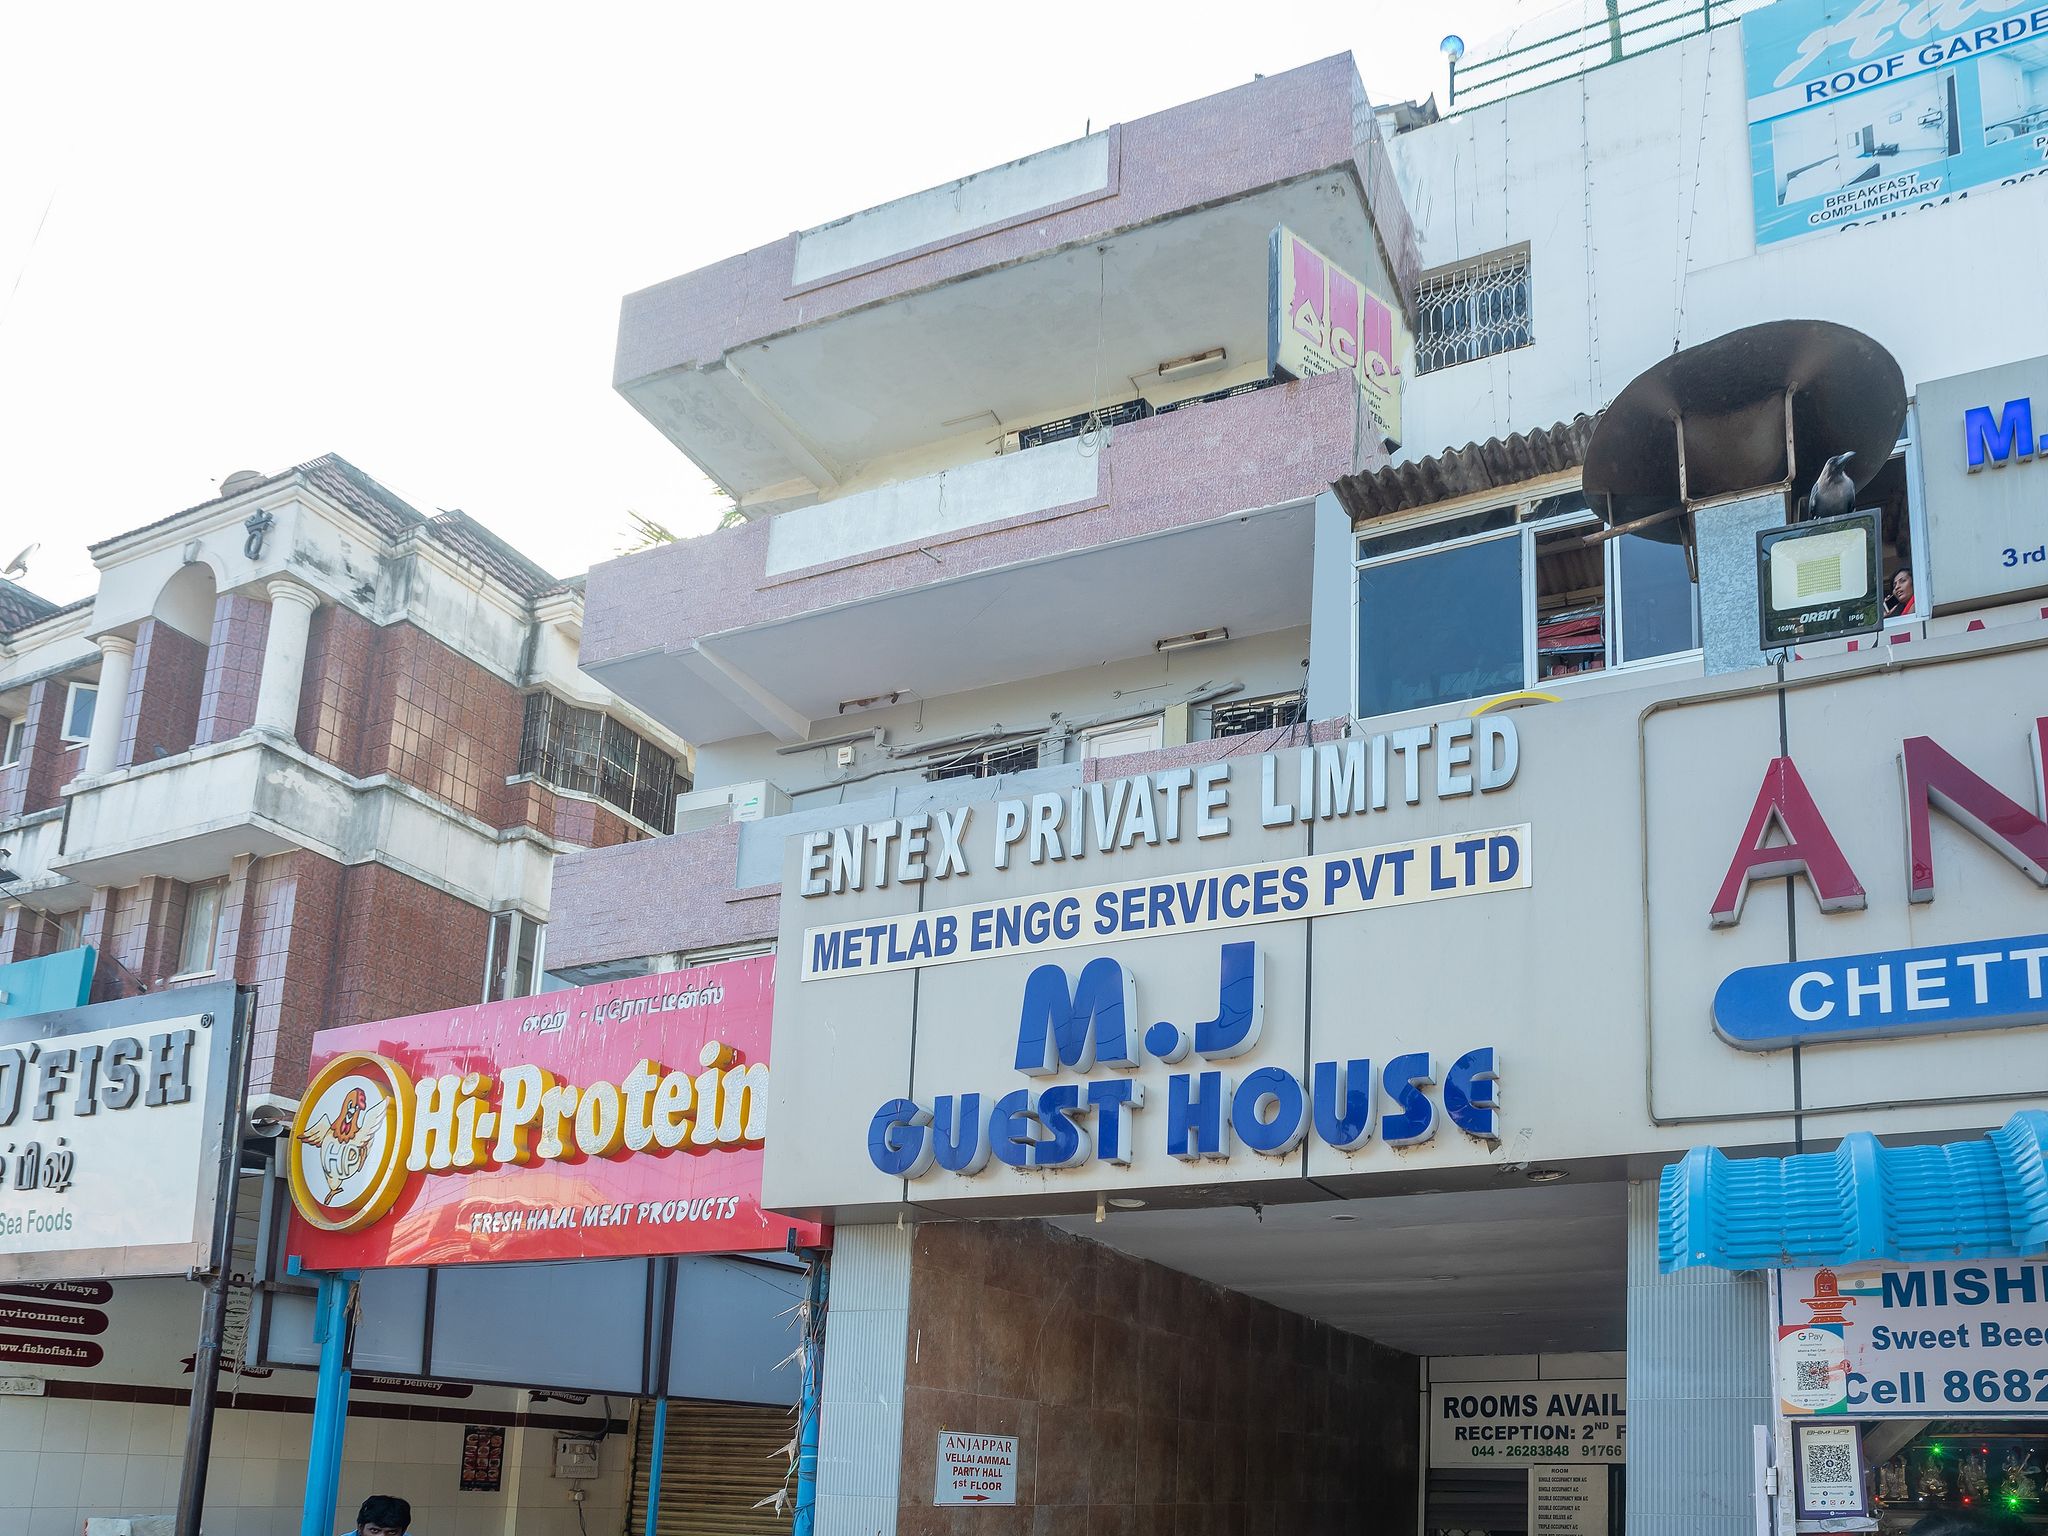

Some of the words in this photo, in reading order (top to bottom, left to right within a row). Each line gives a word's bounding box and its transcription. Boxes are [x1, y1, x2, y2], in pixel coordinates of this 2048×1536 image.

[1804, 55, 1905, 103] ROOF
[1919, 9, 2048, 65] GARDE
[1809, 178, 1941, 224] COMPLIMENTARY
[1826, 174, 1918, 208] BREAKFAST
[1800, 607, 1841, 624] ORBIT
[800, 805, 974, 899] ENTEX
[994, 762, 1232, 870] PRIVATE
[1262, 715, 1521, 828] LIMITED
[812, 915, 958, 973] METLAB
[970, 905, 1080, 952] ENGG
[1093, 864, 1310, 936] SERVICES
[1324, 850, 1415, 905] PVT
[1429, 836, 1521, 890] LTD
[1789, 947, 2048, 1021] CHETT
[1013, 940, 1265, 1077] M.J
[406, 1040, 770, 1173] Hi-Protein
[867, 1078, 1145, 1181] GUEST
[1166, 1047, 1501, 1164] HOUSE
[27, 1207, 73, 1233] Foods
[470, 1210, 522, 1234] FRESH
[525, 1207, 577, 1231] HALAL
[581, 1204, 633, 1228] MEAT
[637, 1196, 739, 1225] PRODUCTS
[53, 1282, 99, 1296] Always
[1882, 1265, 2048, 1308] MISH
[1808, 1332, 1824, 1341] Pay
[1872, 1323, 1970, 1350] Sweet
[1980, 1322, 2048, 1347] Bee
[372, 1377, 401, 1386] Home
[404, 1379, 443, 1391] Delivery
[1847, 1371, 1926, 1404] Cell
[1443, 1395, 1538, 1418] ROOMS
[1546, 1393, 1626, 1417] AVAIL
[946, 1436, 1012, 1453] ANJAPPAR
[1455, 1425, 1576, 1441] RECEPTION:
[1582, 1422, 1609, 1440] 2ND
[945, 1453, 975, 1463] VELLAI
[977, 1455, 1011, 1466] AMMAL
[1472, 1445, 1495, 1457] 044
[1506, 1445, 1569, 1457] 26283848
[1582, 1445, 1622, 1457] 91766
[952, 1479, 967, 1489] 1st
[970, 1481, 1002, 1490] FLOOR
[953, 1466, 980, 1477] PARTY
[982, 1468, 1003, 1477] HALL
